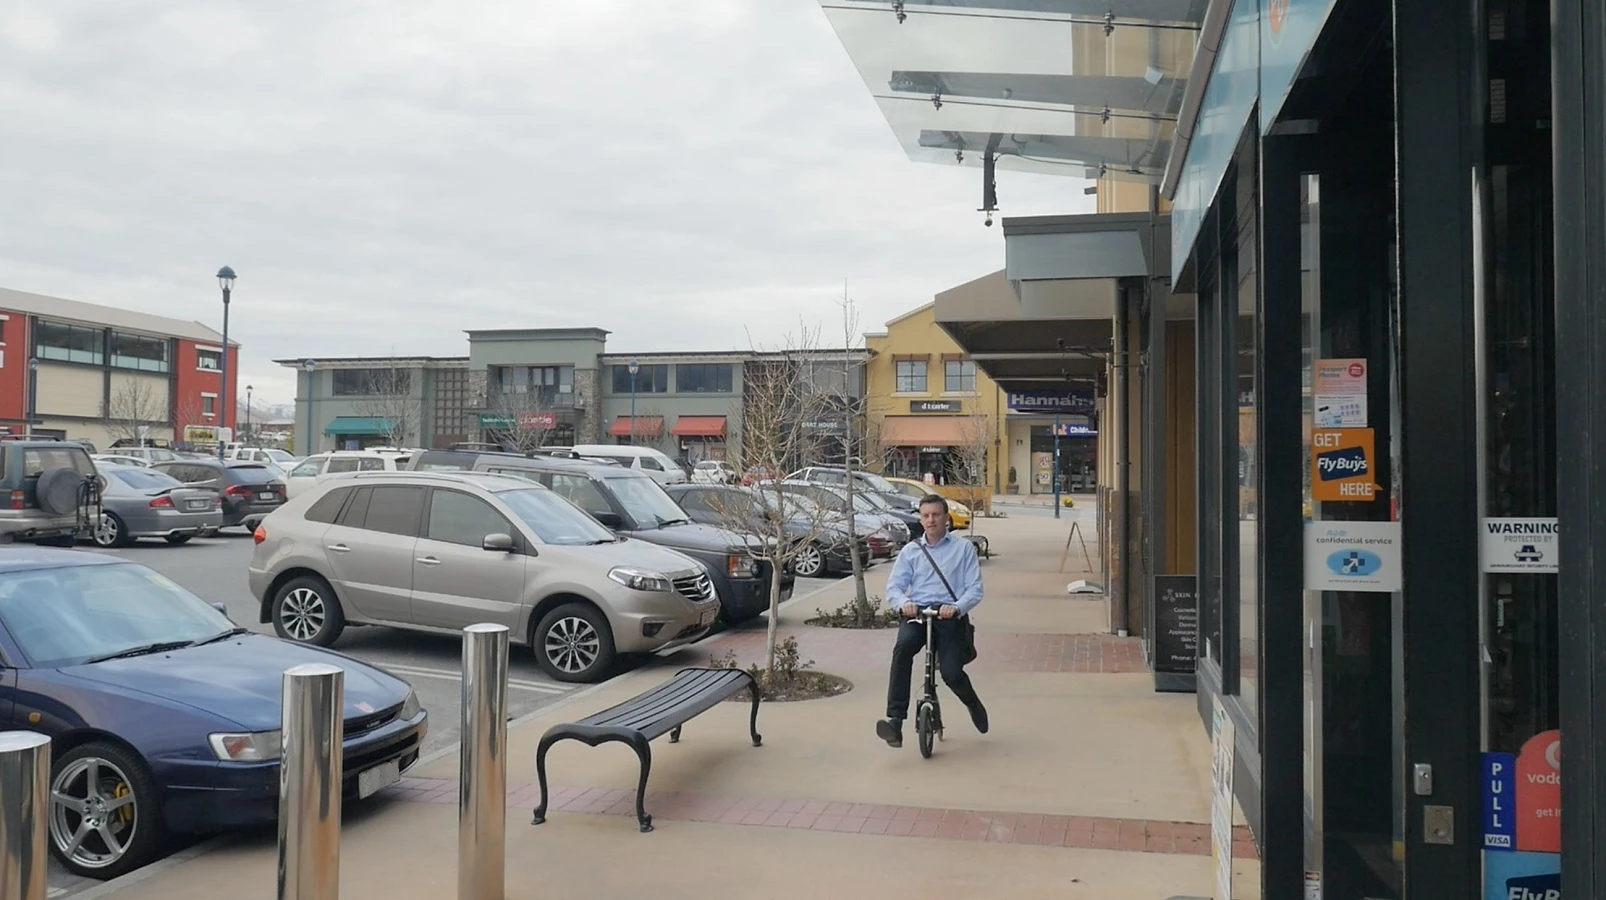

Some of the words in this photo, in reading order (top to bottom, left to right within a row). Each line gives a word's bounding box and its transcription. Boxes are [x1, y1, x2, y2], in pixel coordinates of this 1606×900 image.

[1314, 433, 1342, 447] GET
[1340, 483, 1373, 496] HERE
[1316, 537, 1364, 545] confidential
[1364, 537, 1393, 545] service
[1504, 535, 1542, 543] PROTECTED
[1543, 535, 1552, 543] BY
[1491, 762, 1503, 828] PULL
[1536, 808, 1553, 818] get
[1487, 835, 1509, 845] VISA
